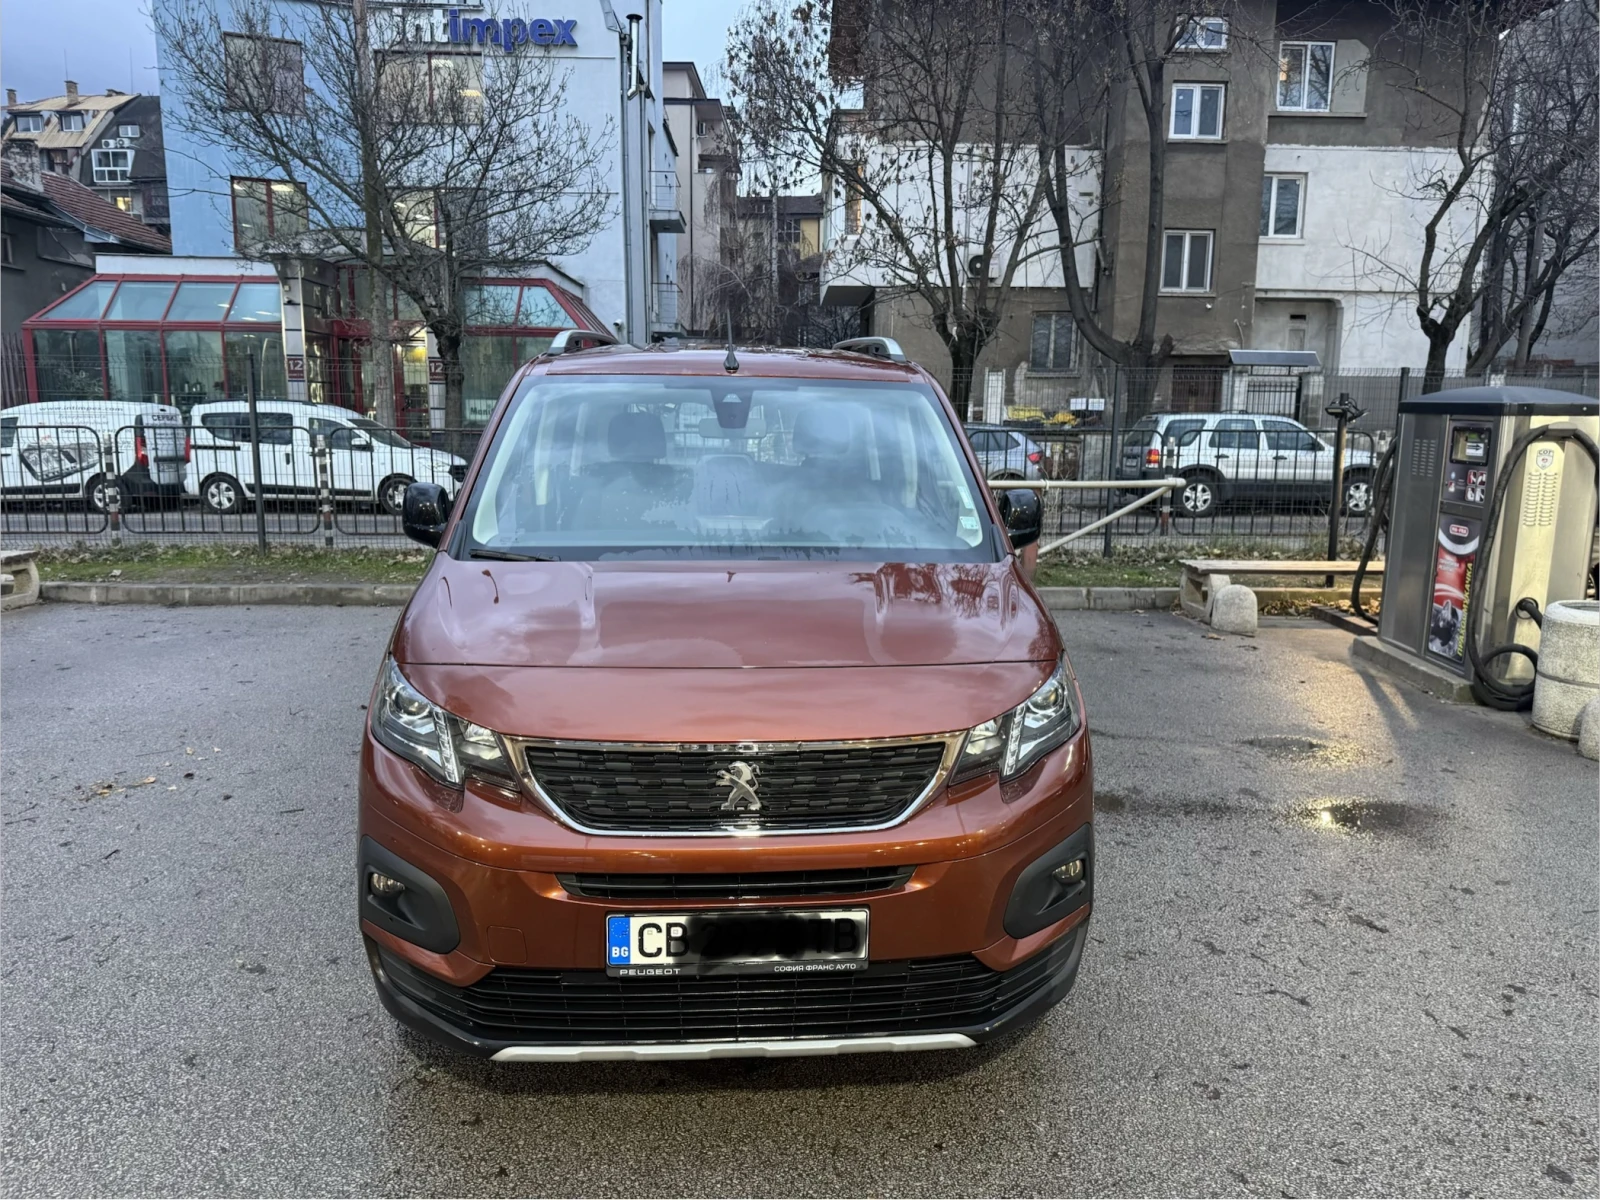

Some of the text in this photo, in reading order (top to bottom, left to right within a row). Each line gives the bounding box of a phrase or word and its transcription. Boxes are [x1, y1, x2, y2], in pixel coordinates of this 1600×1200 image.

[289, 360, 303, 370] 12
[430, 362, 444, 373] 12
[612, 946, 629, 957] BG
[619, 968, 681, 976] PEUGEOT
